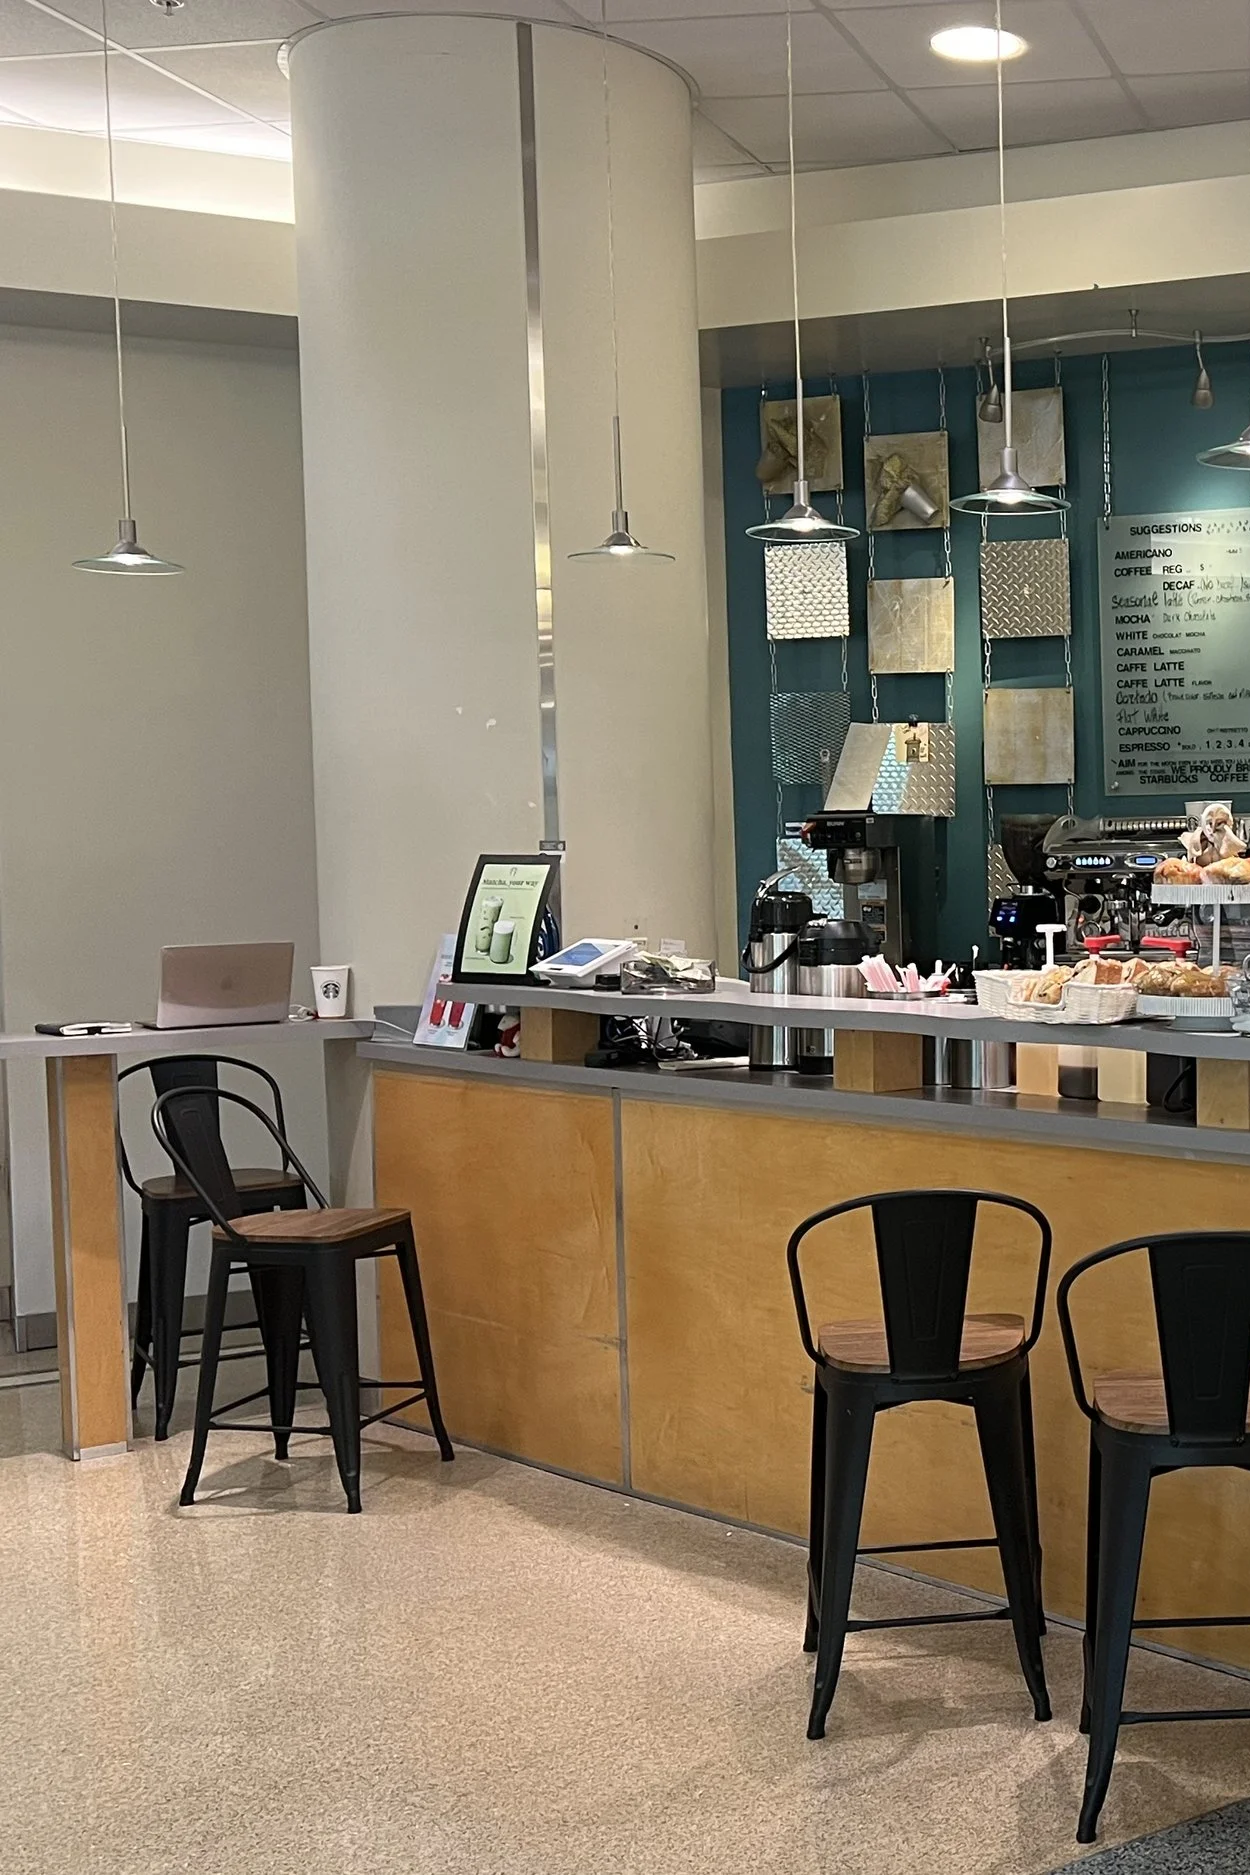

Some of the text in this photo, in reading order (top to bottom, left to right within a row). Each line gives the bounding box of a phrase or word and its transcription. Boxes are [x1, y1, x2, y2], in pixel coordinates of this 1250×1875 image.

[1130, 523, 1202, 536] SUGGESTIONS
[1114, 548, 1173, 560] AMERICANO
[1114, 566, 1152, 577] COFFEE
[1162, 564, 1183, 574] REG
[1163, 580, 1195, 591] DECAF
[1115, 615, 1151, 624] MOCHA
[1116, 631, 1148, 640] WHITE
[1116, 646, 1164, 657] CARAMEL
[1117, 661, 1185, 672] CAFFE LATTE
[1117, 679, 1148, 688] CAFFE
[1154, 678, 1185, 687] LATTE
[1118, 726, 1181, 736] CAPPUCCINO
[1119, 742, 1170, 752] ESPRESSO
[1171, 766, 1186, 775] WE
[1190, 764, 1232, 773] PROUDLY
[1140, 772, 1249, 784] STARBUCKS COFFEE
